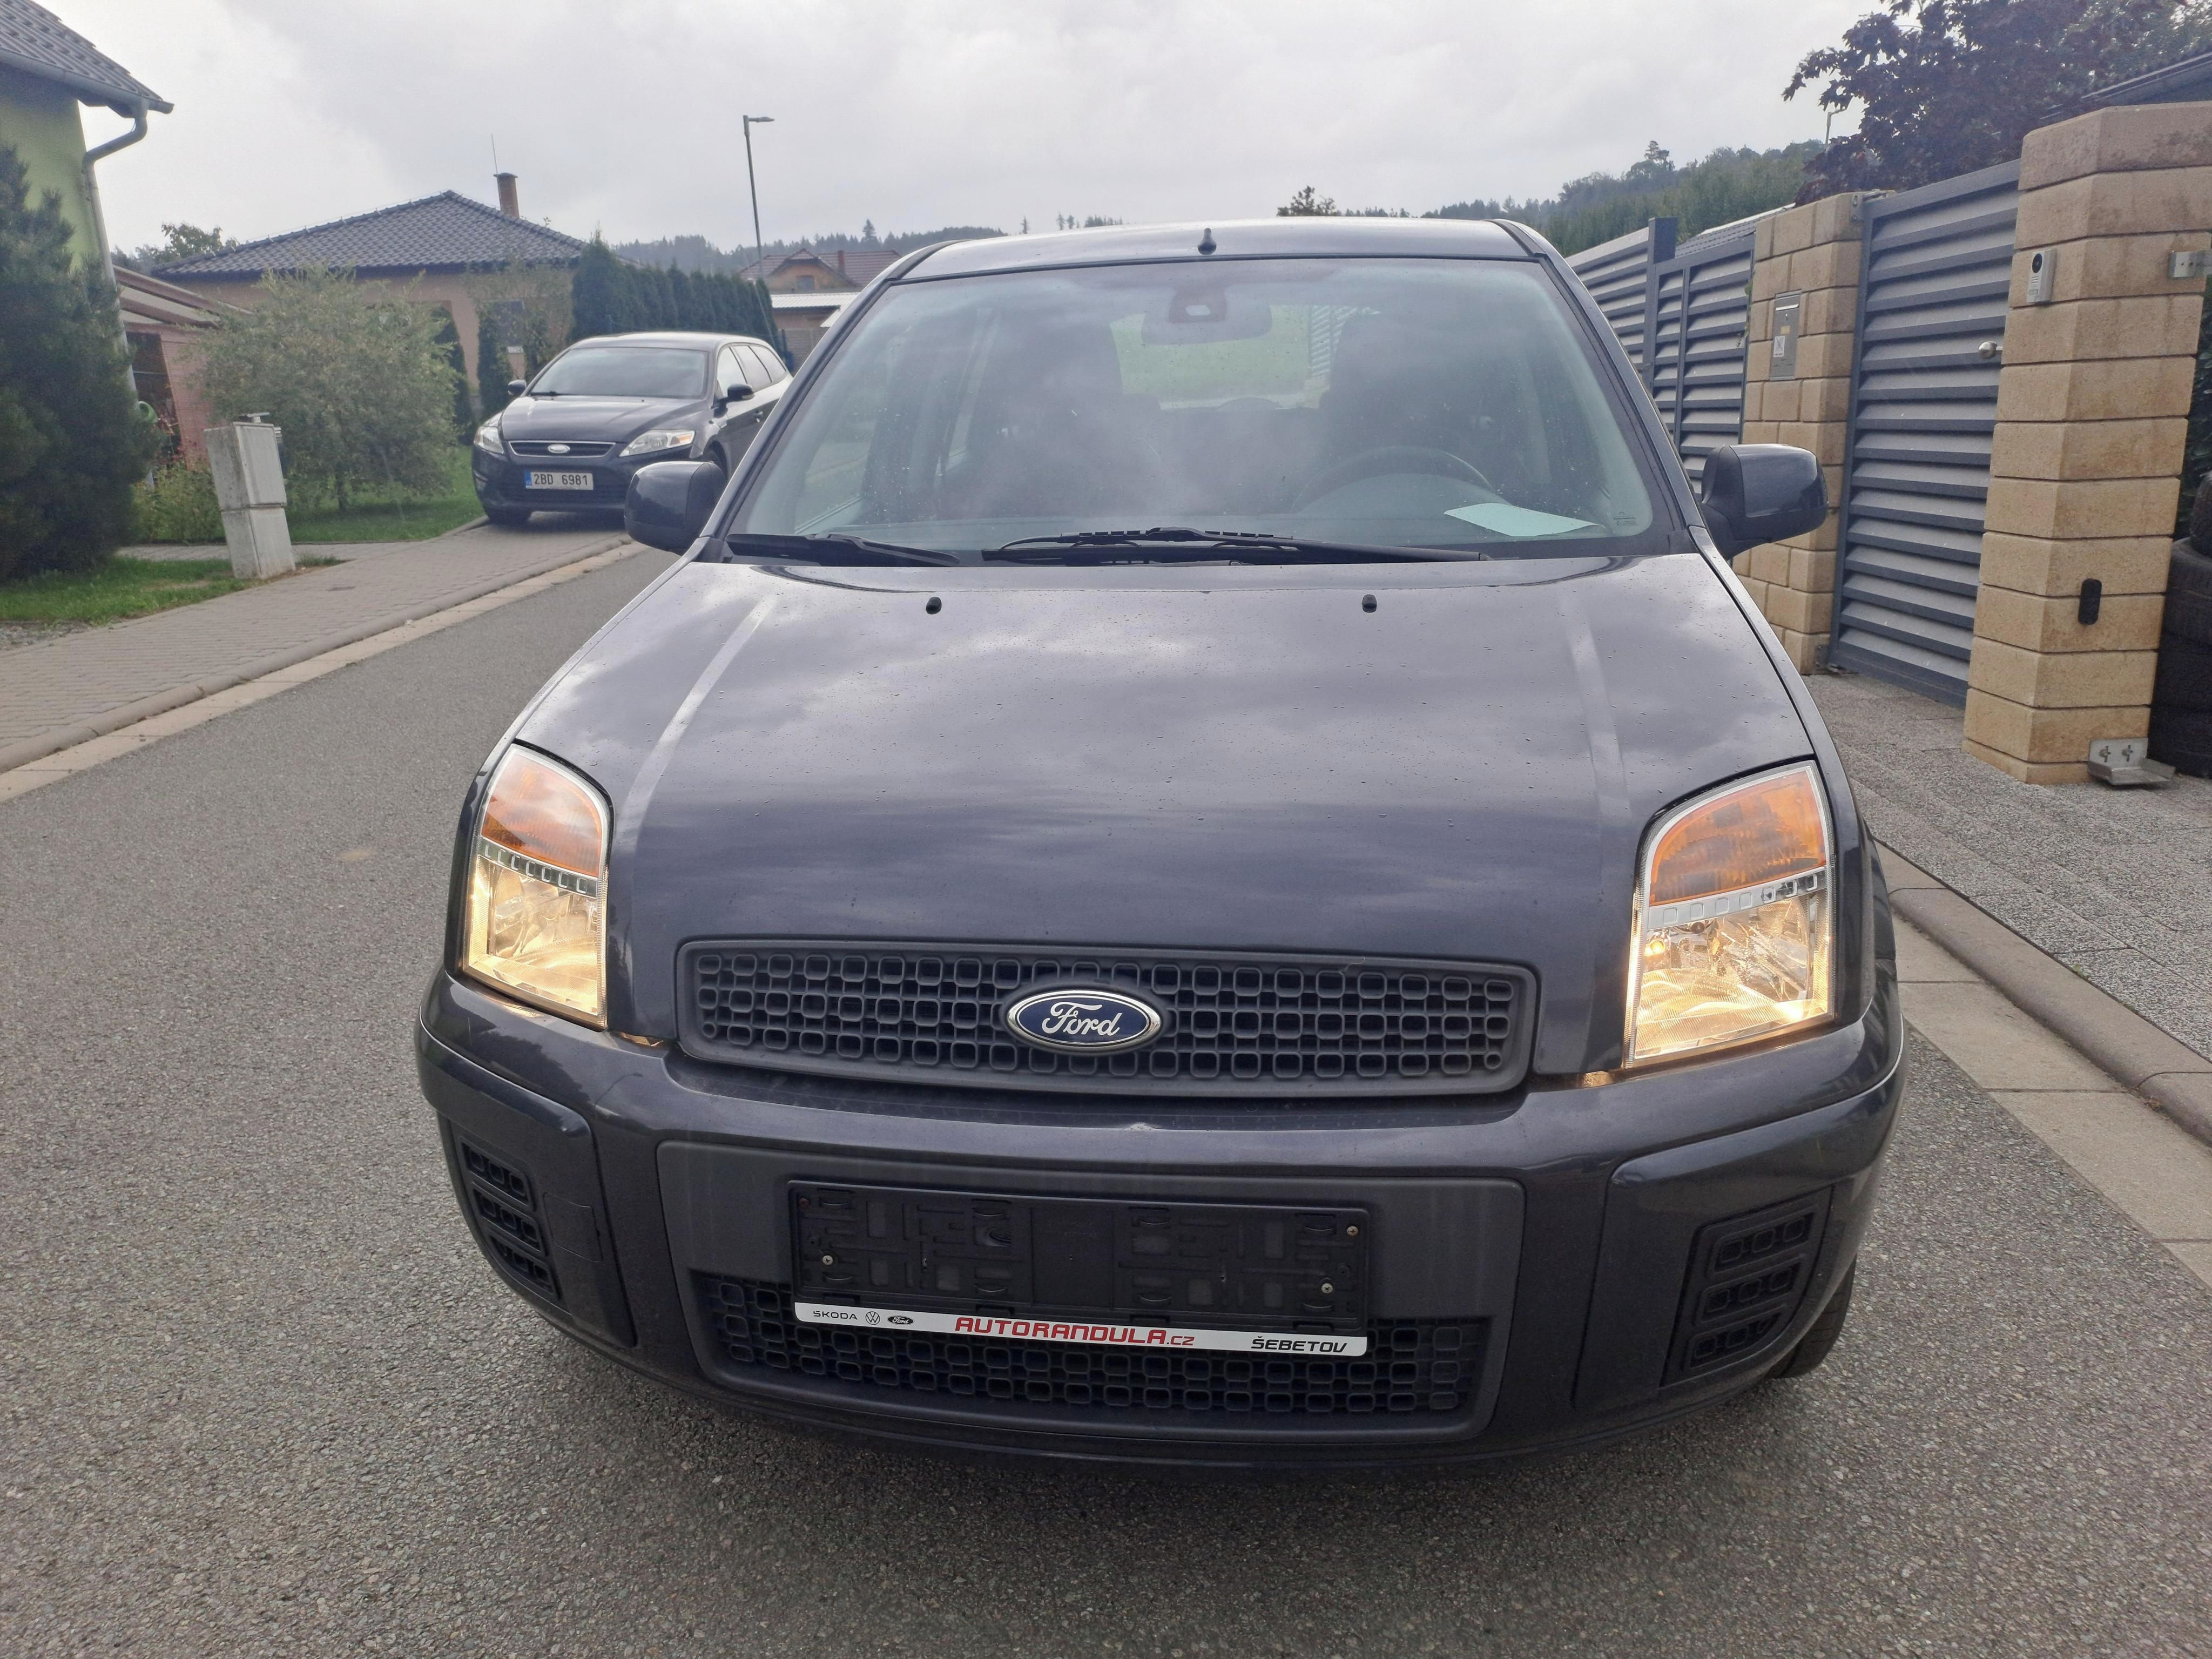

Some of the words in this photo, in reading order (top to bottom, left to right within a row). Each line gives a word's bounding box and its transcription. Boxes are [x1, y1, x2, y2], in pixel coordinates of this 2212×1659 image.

[534, 474, 554, 485] 2BD
[562, 474, 588, 485] 6981
[1042, 1001, 1123, 1036] Ford
[1251, 1336, 1347, 1353] ŠEBETOV
